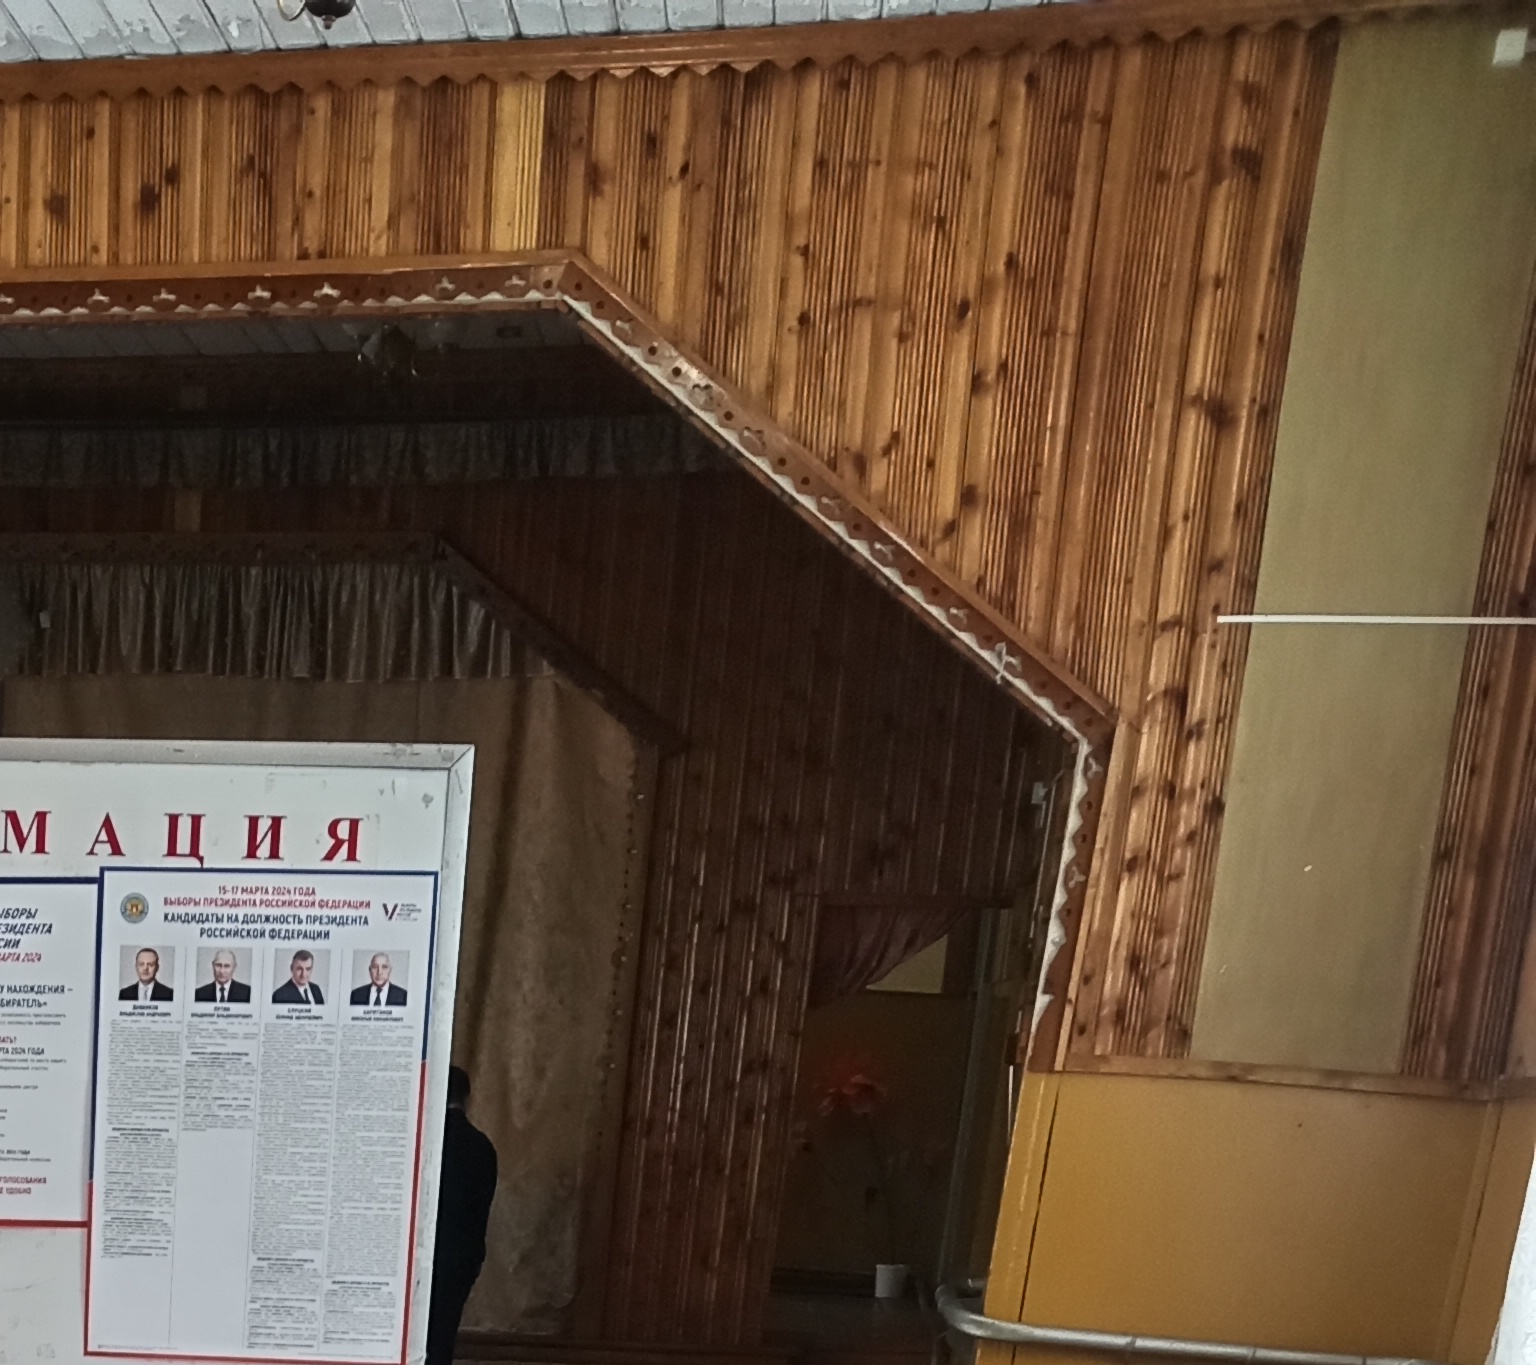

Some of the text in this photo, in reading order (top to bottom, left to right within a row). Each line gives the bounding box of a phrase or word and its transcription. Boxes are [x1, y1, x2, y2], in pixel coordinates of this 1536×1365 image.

[240, 886, 269, 895] МАРТА
[271, 886, 291, 896] 2024
[293, 887, 316, 896] ГОДА
[164, 897, 371, 909] ВЫБОРЫ ПРЕЗИДЕНТА РОССИЙСКОЙ ФЕДЕРАЦИИ
[164, 912, 369, 926] КАНДИДАТЫ НА ДОЛЖНОСТЬ ПРЕЗИДЕНТА
[200, 926, 330, 940] РОССИЙСКОЙ ФЕДЕРАЦИИ
[22, 953, 42, 962] 2024
[7, 984, 65, 995] НАХОЖДЕНИЯ
